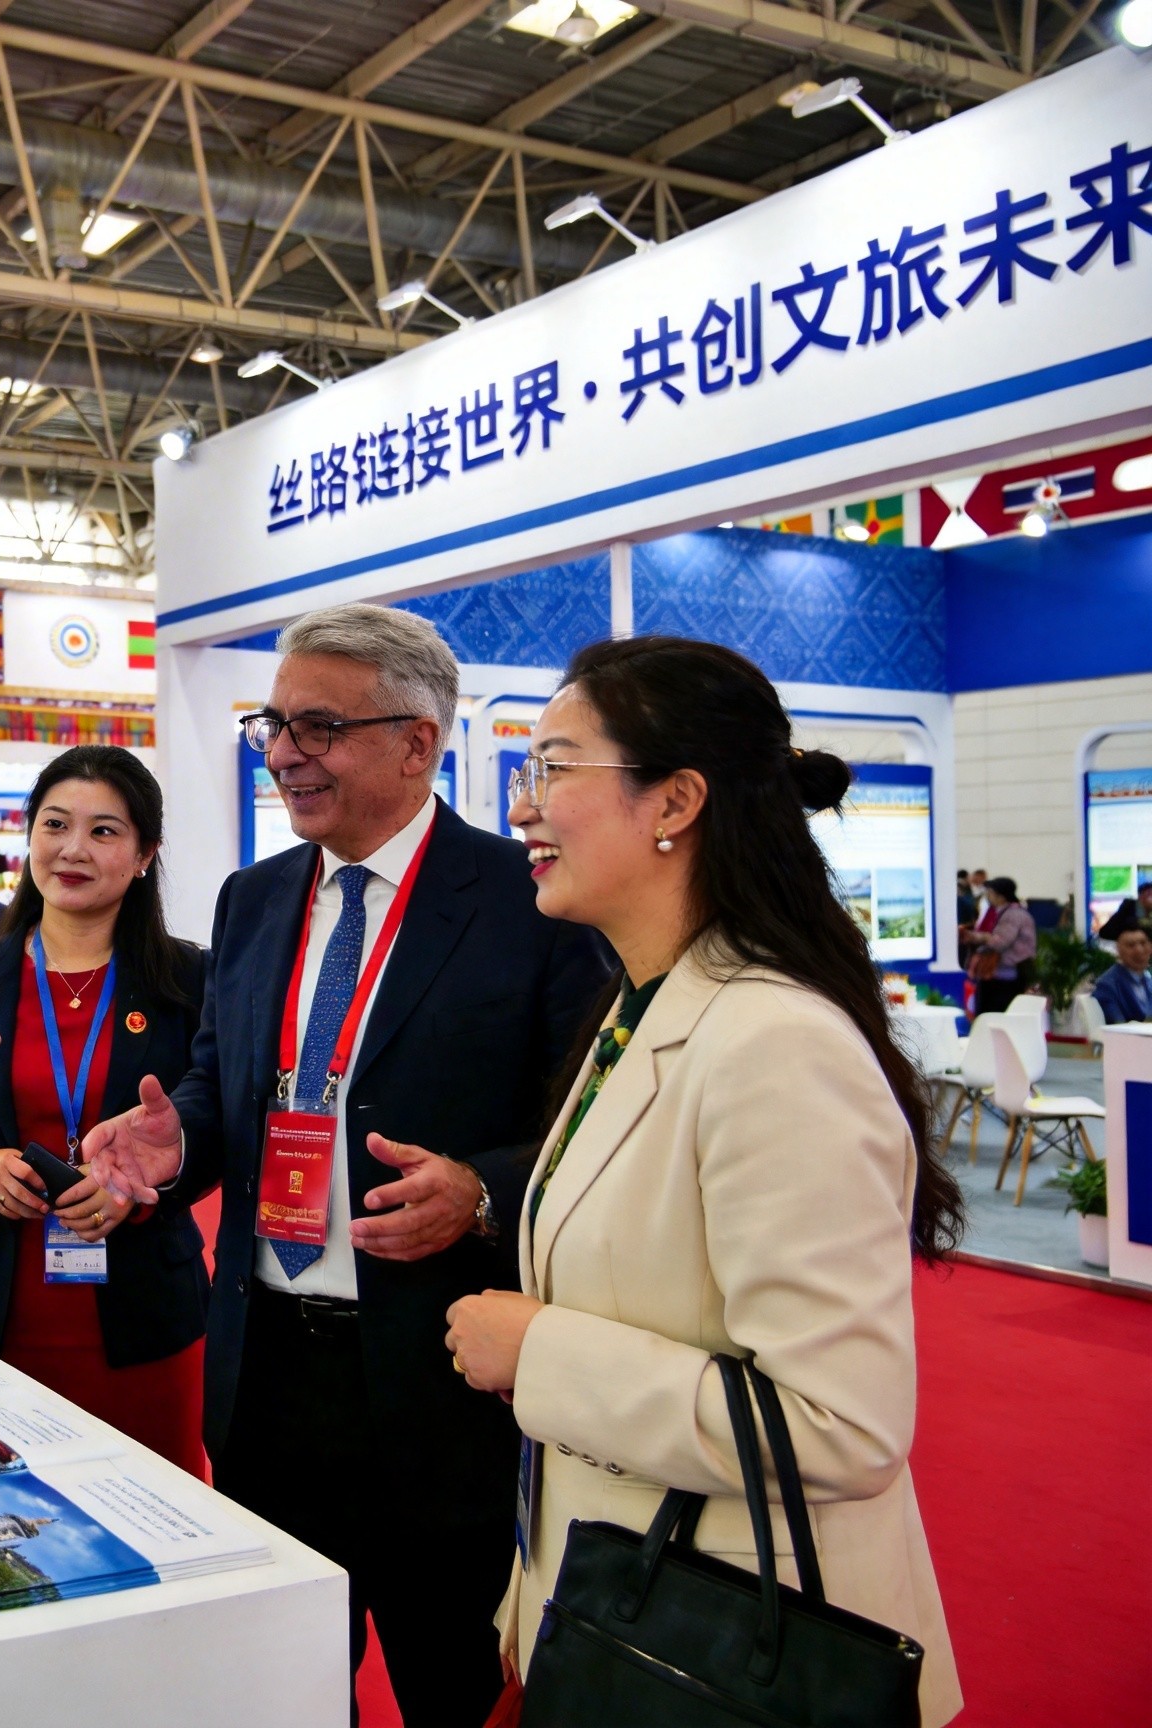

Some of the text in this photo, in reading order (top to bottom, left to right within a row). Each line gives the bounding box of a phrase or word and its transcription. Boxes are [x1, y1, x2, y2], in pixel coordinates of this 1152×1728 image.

[267, 141, 1152, 533] 丝路链接世界·共创文旅未来
